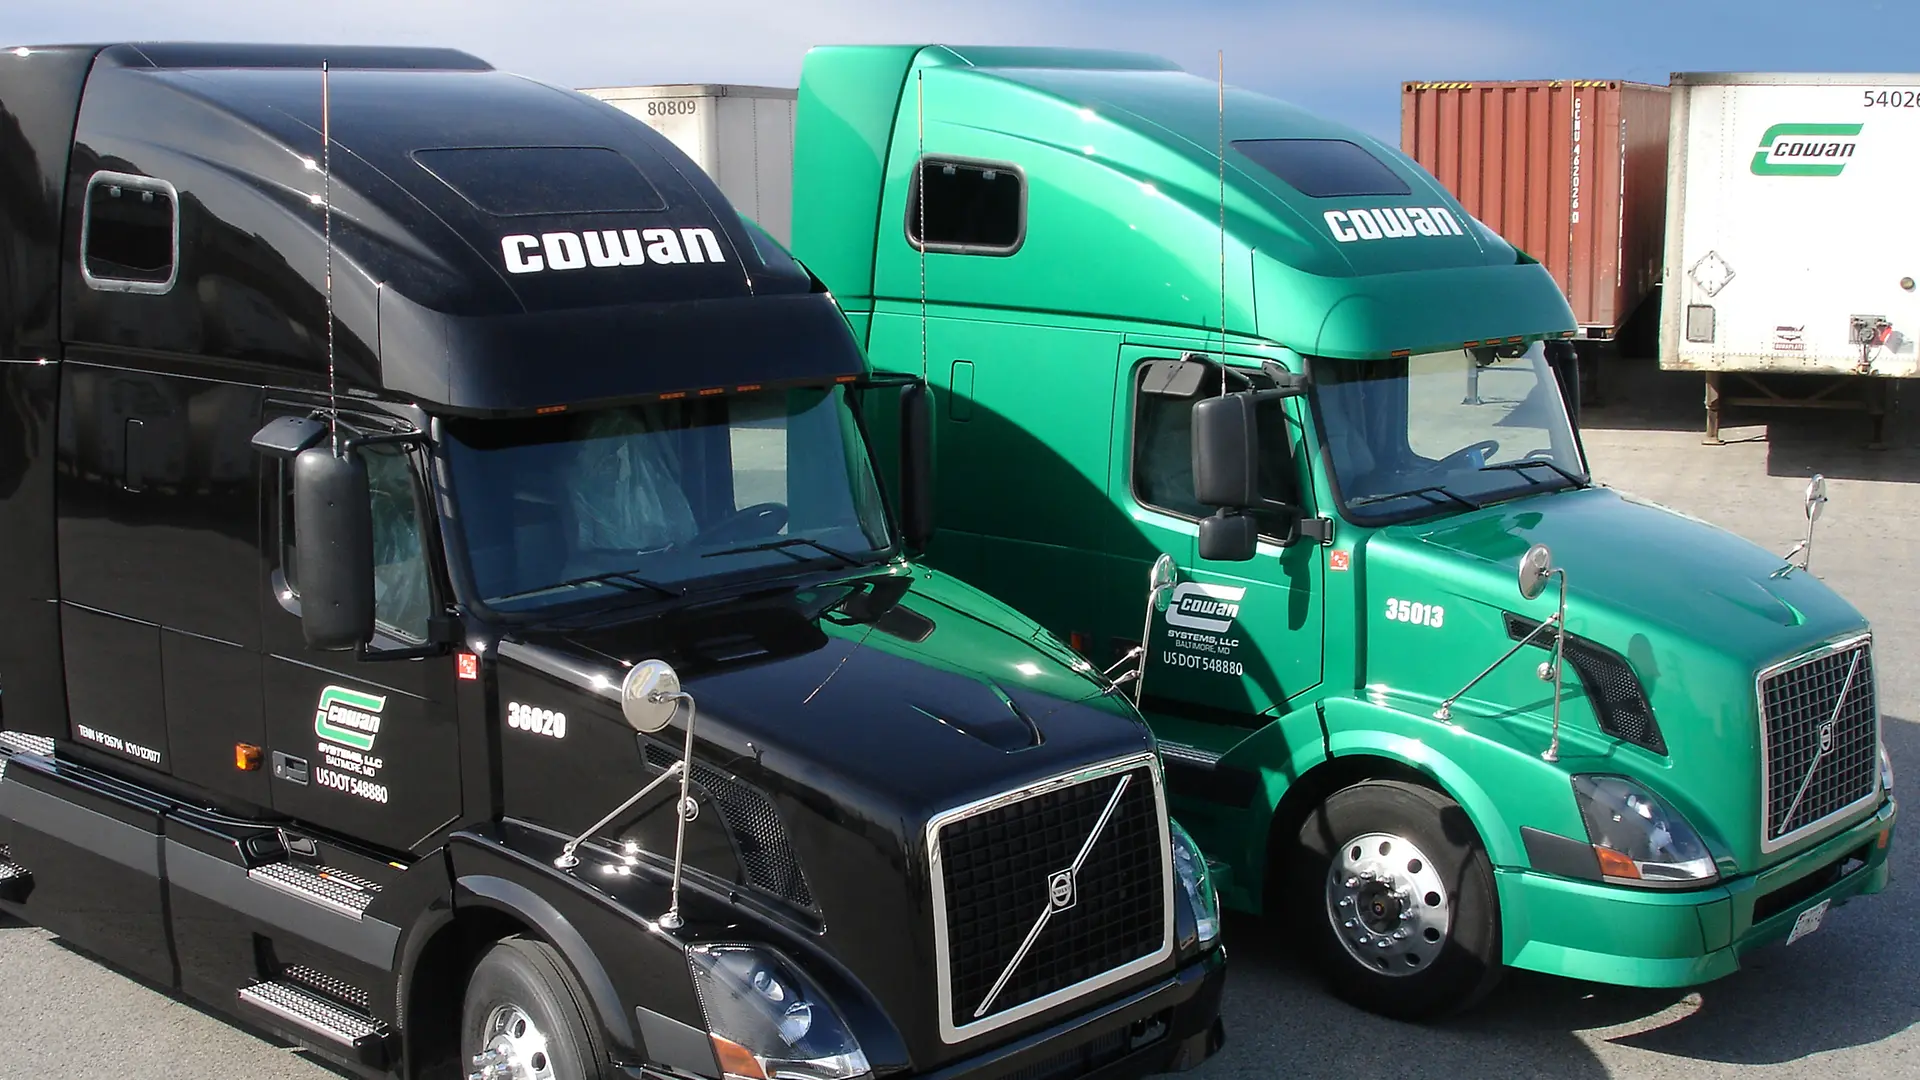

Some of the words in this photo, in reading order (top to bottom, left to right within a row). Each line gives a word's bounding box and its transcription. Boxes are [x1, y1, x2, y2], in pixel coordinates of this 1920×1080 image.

[648, 101, 696, 116] 80809
[1385, 597, 1444, 628] 35013
[1167, 629, 1218, 646] SYSTEMS,
[1219, 637, 1239, 647] LLC
[1175, 639, 1216, 654] BALTIMORE,
[1217, 646, 1230, 655] MD
[1163, 650, 1177, 665] US
[1178, 653, 1201, 669] DOT
[1202, 657, 1243, 676] 548880
[507, 701, 566, 739] 36020
[325, 754, 362, 774] BALTIMORE,
[362, 765, 375, 777] MD
[364, 755, 383, 769] LLC
[350, 777, 388, 803] 548880
